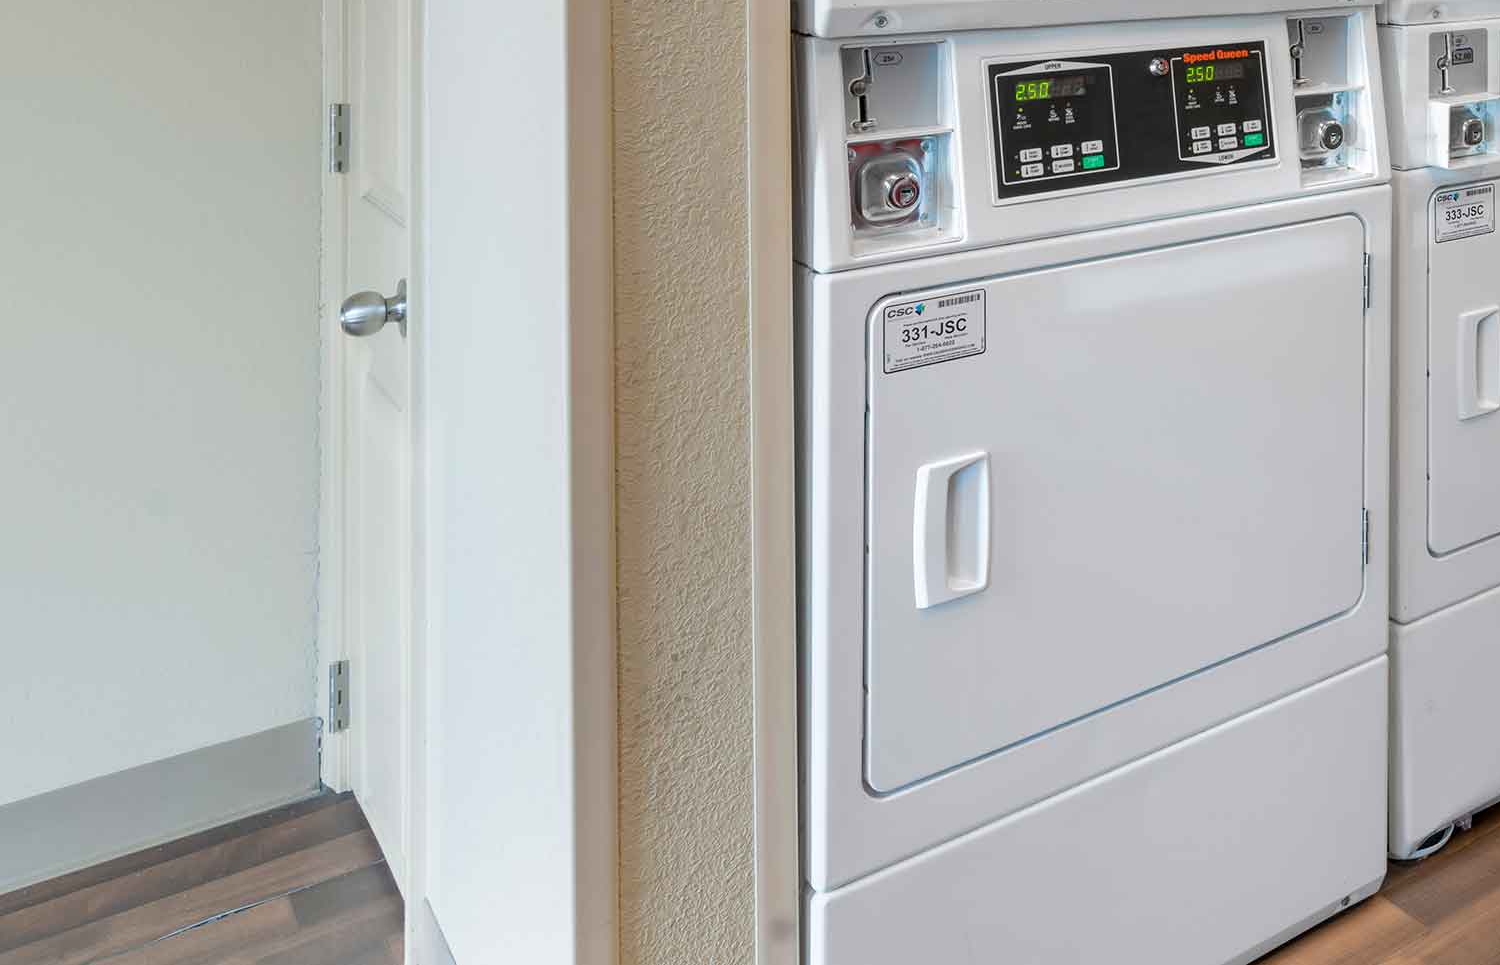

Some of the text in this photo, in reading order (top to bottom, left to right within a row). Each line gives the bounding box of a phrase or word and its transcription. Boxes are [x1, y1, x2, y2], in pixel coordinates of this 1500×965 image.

[1183, 49, 1249, 63] Speed Queen
[1437, 194, 1453, 203] CSC
[1445, 204, 1484, 221] 333-JSC
[887, 307, 914, 318] CSC
[901, 318, 967, 343] 331-JSC
